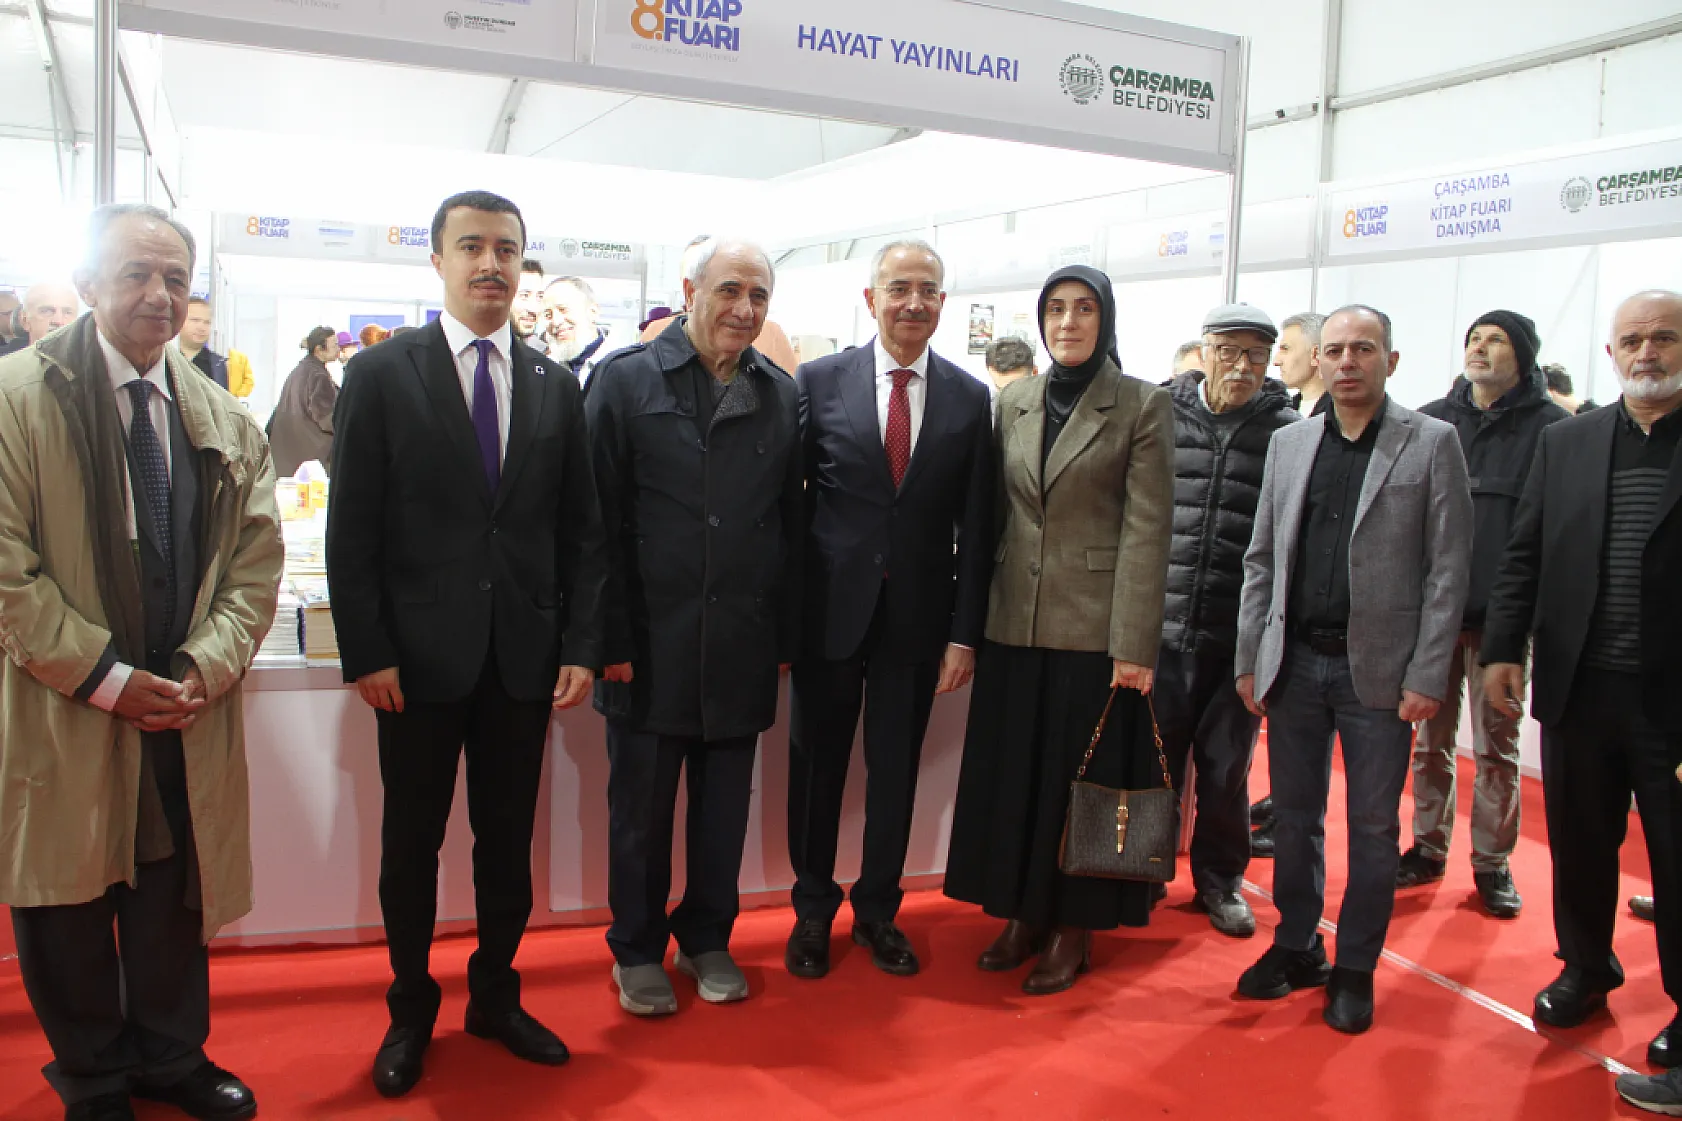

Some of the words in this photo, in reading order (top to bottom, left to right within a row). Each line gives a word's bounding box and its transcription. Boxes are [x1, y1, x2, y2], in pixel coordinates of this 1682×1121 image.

[664, 18, 739, 51] FUARI
[797, 24, 883, 60] HAYAT
[891, 38, 1019, 82] YAYINLARI
[1109, 65, 1215, 101] ÇARŞAMBA
[1113, 89, 1211, 120] BELEDİYESİ
[1434, 172, 1510, 200] ÇARŞAMBA
[1430, 203, 1467, 221] KİTAP
[1470, 197, 1511, 217] FUARI
[1356, 220, 1387, 238] FUARI
[1436, 218, 1502, 238] DANIŞMA
